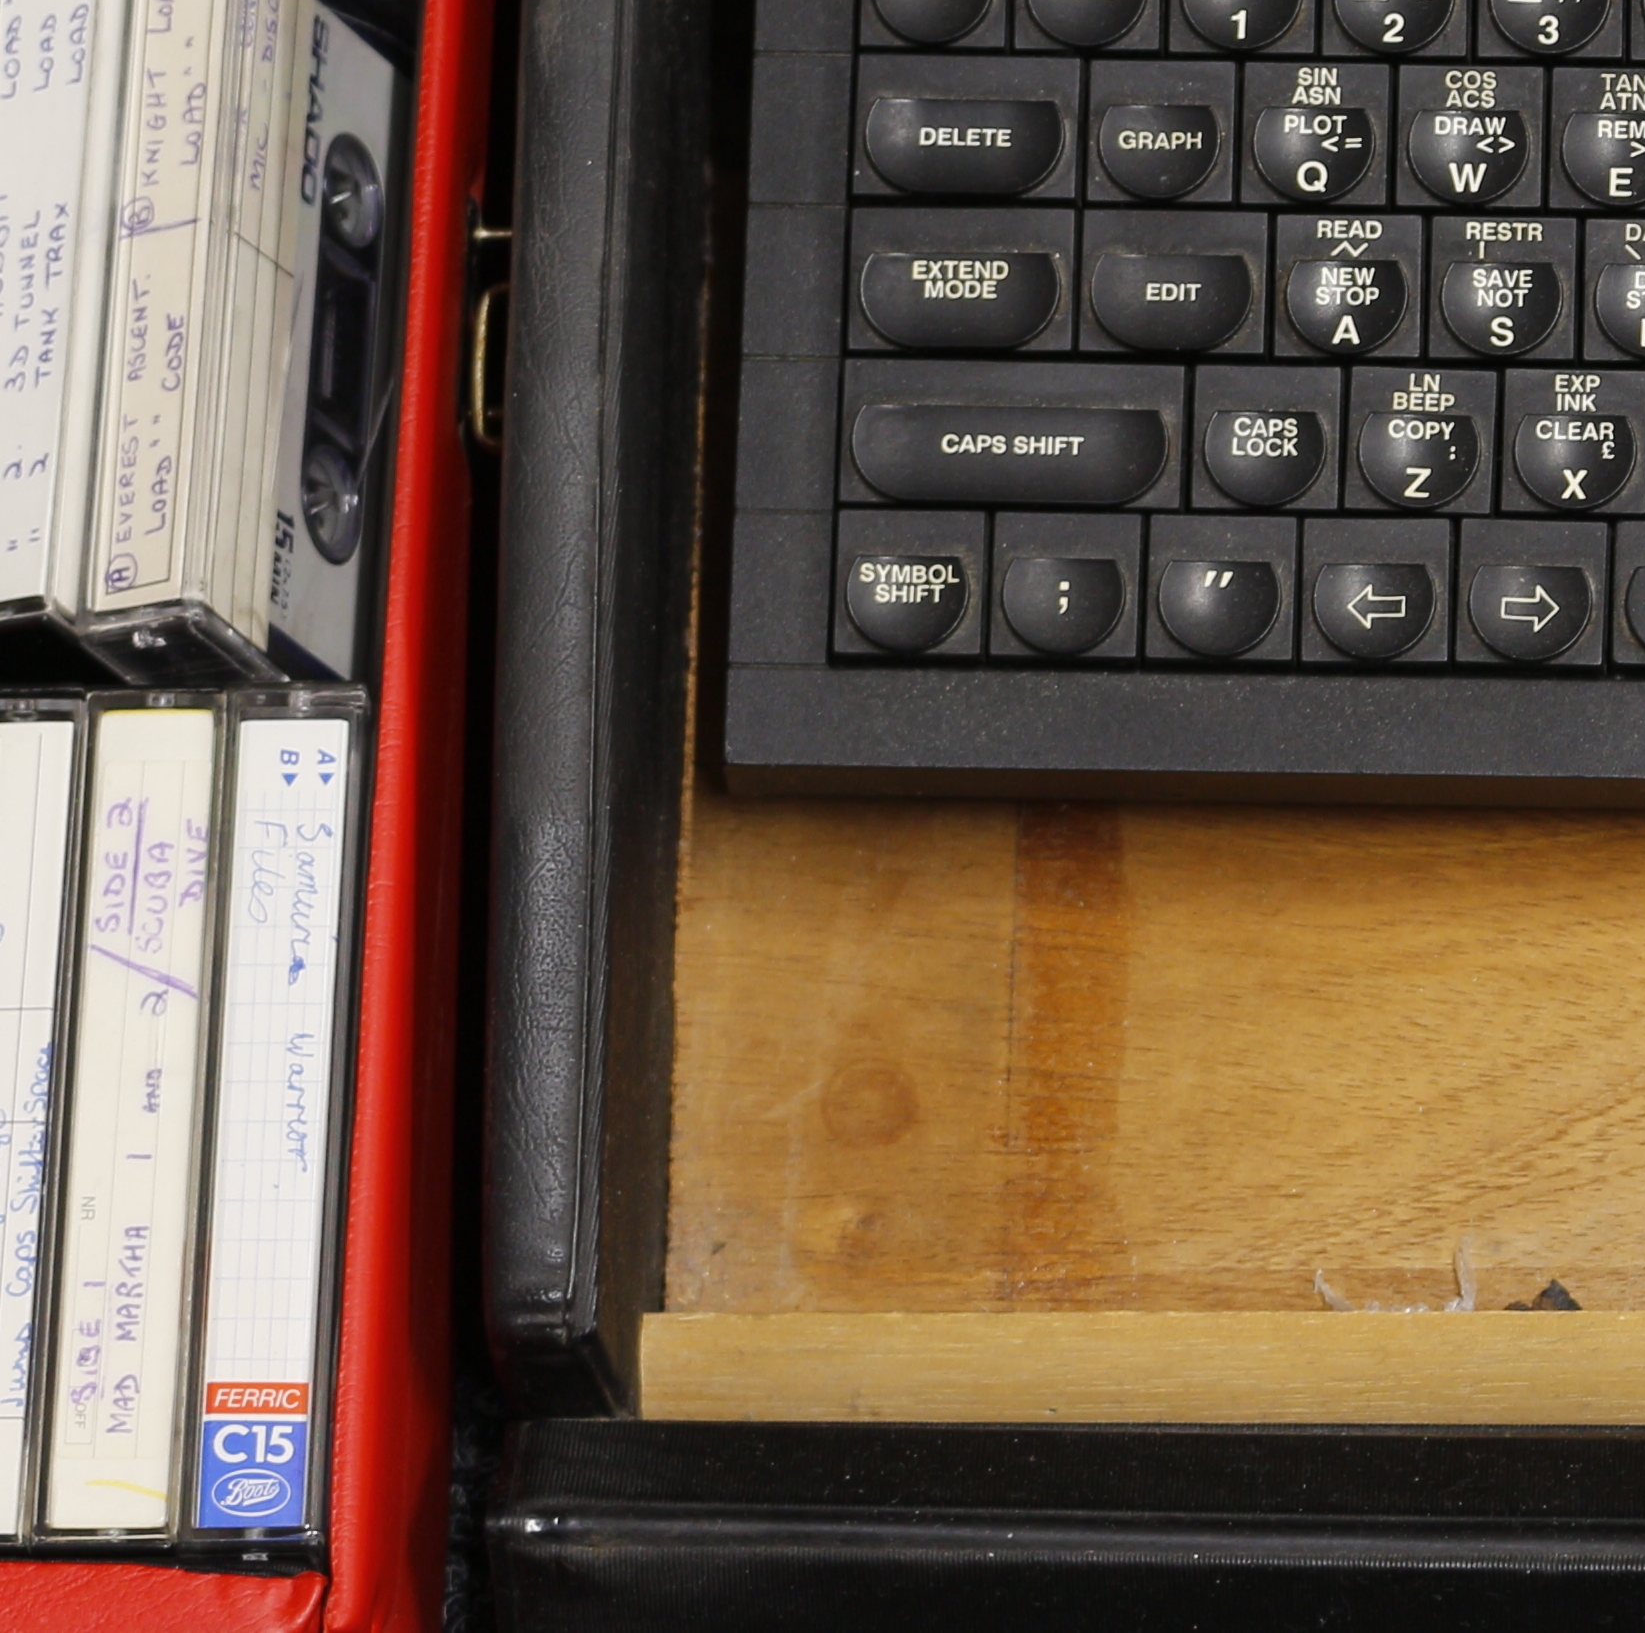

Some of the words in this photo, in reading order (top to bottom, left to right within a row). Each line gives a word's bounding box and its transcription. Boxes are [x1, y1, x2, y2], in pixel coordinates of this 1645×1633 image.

[1297, 67, 1338, 86] SIN
[140, 67, 168, 187] KNIGHT
[1283, 114, 1347, 136] PLOT
[919, 127, 1012, 147] DELETE
[1118, 130, 1203, 150] GRAPH
[1317, 219, 1383, 239] READ
[1466, 221, 1543, 242] RESTR
[45, 203, 69, 288] TRAX
[14, 210, 42, 331] TUNNEL
[911, 260, 1009, 280] EXTEND
[1472, 268, 1533, 291] SAVE
[924, 279, 998, 299] MODE
[1145, 282, 1202, 302] EDIT
[1315, 283, 1380, 306] STOP
[34, 308, 60, 388] TANK
[160, 312, 186, 393] CODE
[1392, 391, 1455, 412] BEEP
[1233, 416, 1298, 438] CAPS
[1387, 418, 1455, 441] COPY
[1535, 420, 1614, 441] CLEAR
[941, 433, 1007, 454] CAPS
[1013, 435, 1085, 456] SHIFT
[1231, 436, 1298, 457] LOCK
[115, 413, 139, 544] EVEREST
[859, 562, 960, 586] SYMBOL
[874, 583, 945, 603] SHIFT
[280, 748, 299, 766] B
[317, 748, 337, 766] A
[178, 817, 209, 907] DIVE
[94, 851, 128, 933] SIDE
[136, 840, 174, 954] SCUBA
[115, 1225, 151, 1342] MARTHA
[105, 1374, 141, 1434] MAD
[215, 1388, 301, 1409] FERRIC
[213, 1423, 296, 1464] C15
[220, 1477, 280, 1507] Boots
